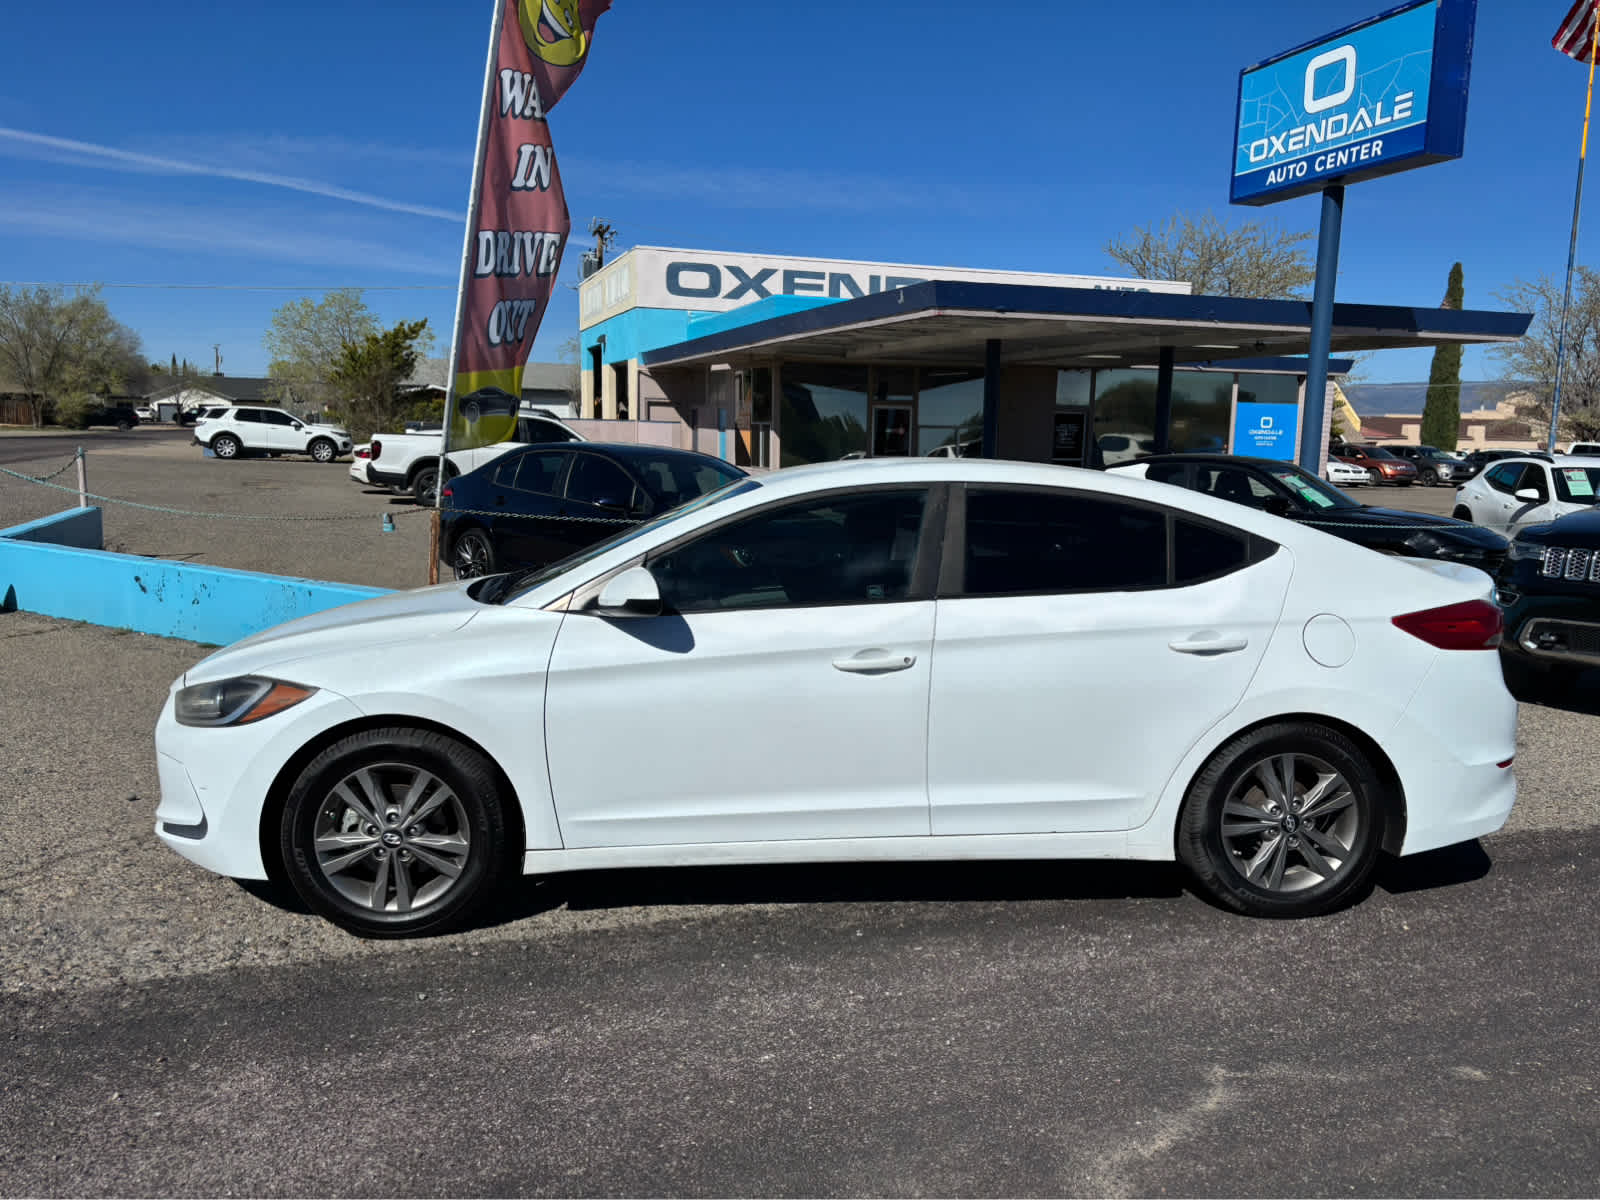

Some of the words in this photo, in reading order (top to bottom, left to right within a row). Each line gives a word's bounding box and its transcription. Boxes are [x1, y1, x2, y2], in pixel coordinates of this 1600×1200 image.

[500, 69, 545, 119] WA
[1304, 44, 1357, 115] O
[1249, 91, 1414, 164] OXENDALE
[511, 143, 553, 191] IN
[1265, 161, 1308, 186] AUTO
[1314, 140, 1384, 172] CENTER
[474, 229, 561, 277] DRIVE
[488, 298, 537, 346] OUT
